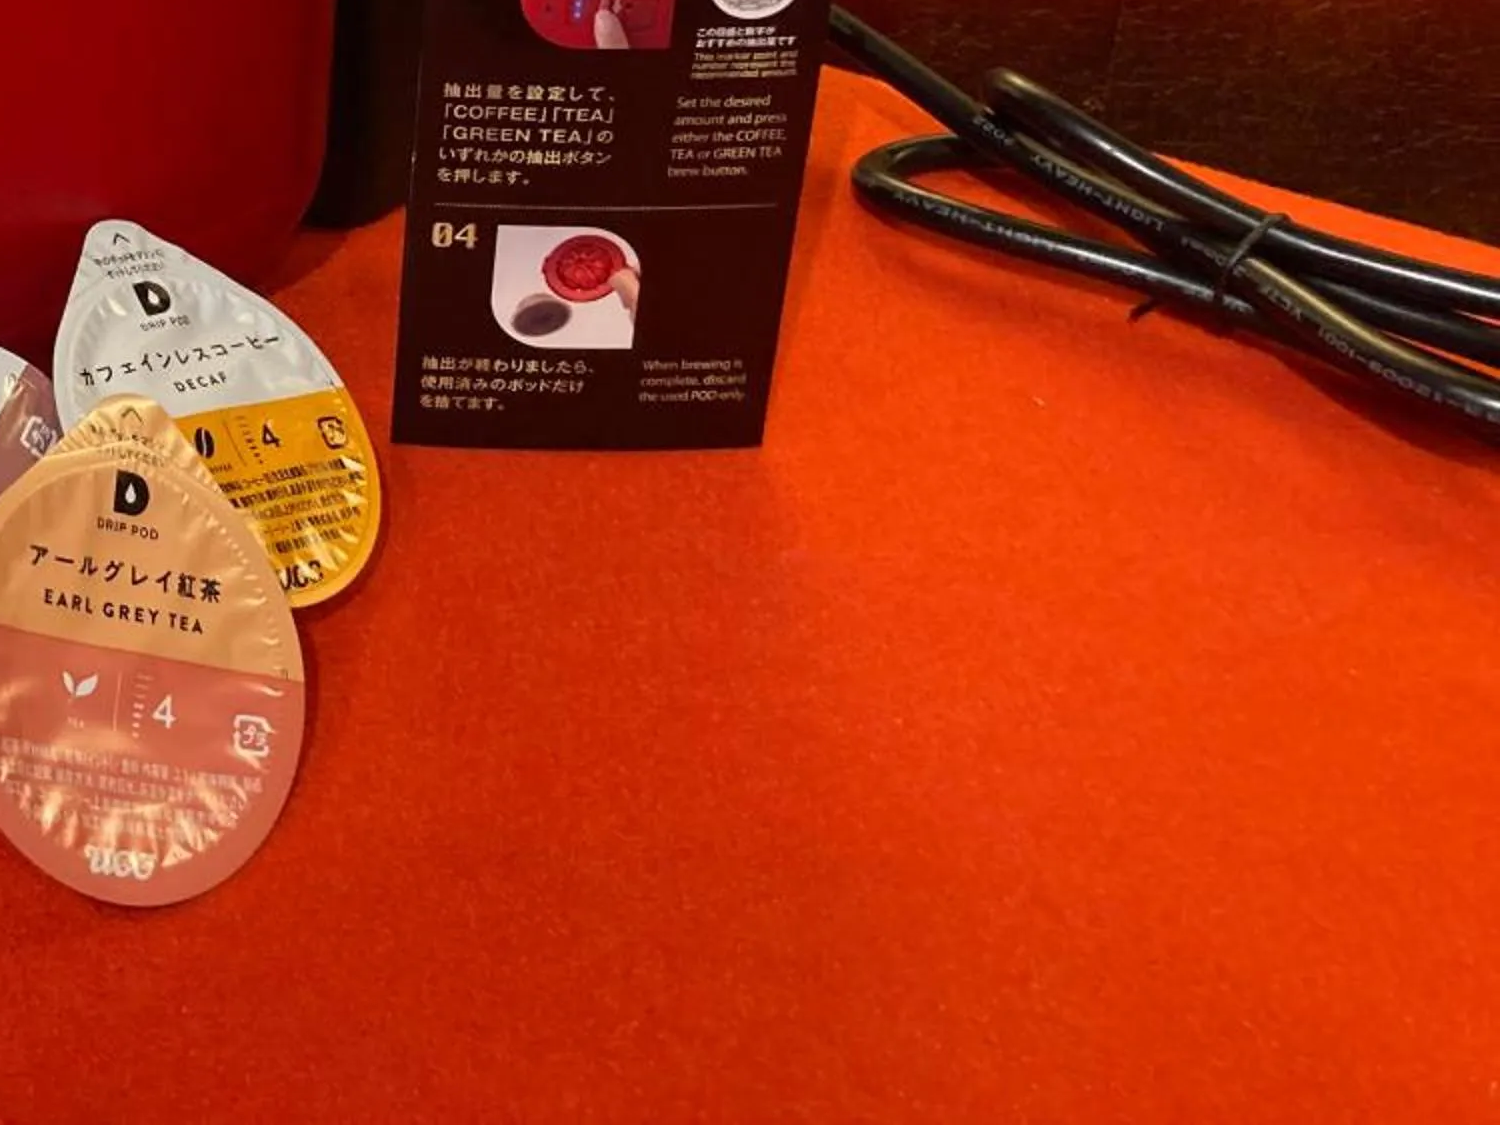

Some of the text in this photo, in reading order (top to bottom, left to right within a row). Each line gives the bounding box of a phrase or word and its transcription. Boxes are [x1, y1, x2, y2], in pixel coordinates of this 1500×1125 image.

[432, 222, 479, 250] 04
[79, 335, 279, 386] カフェインレスコーヒー
[173, 371, 227, 393] DECAF
[261, 419, 282, 449] 4
[97, 515, 159, 541] DRIP POD
[30, 543, 222, 604] アールグレイ紅茶
[44, 588, 204, 635] EARL GREY TEA
[152, 694, 177, 729] 4
